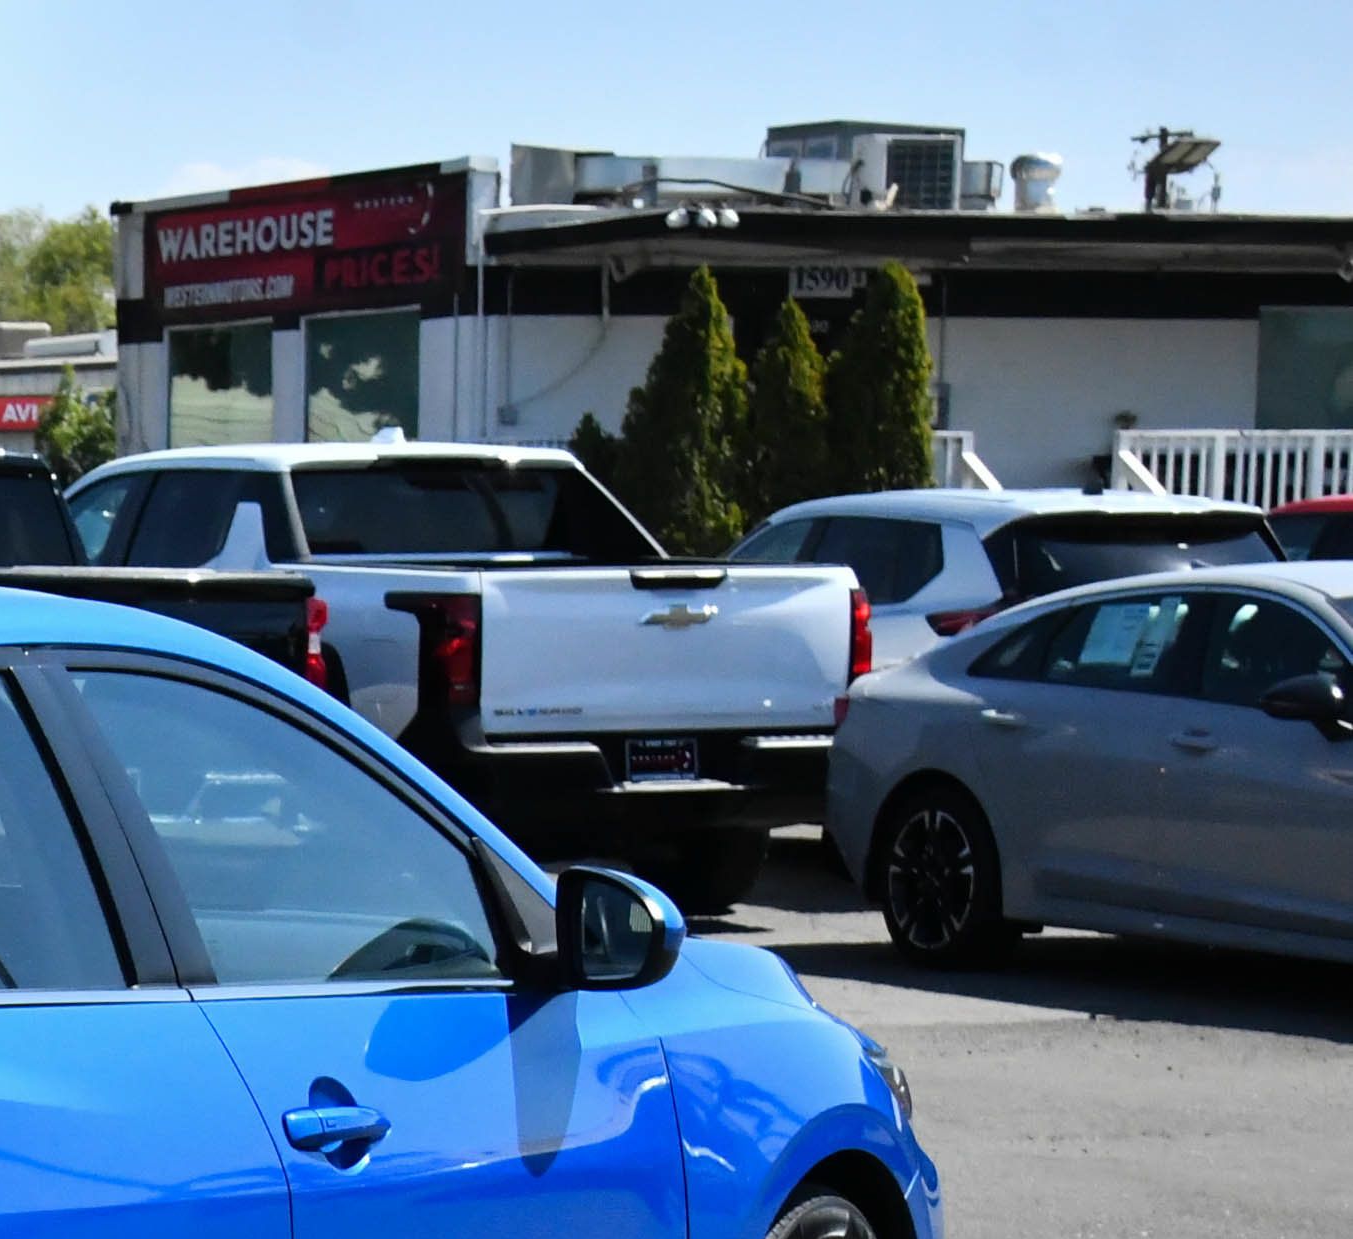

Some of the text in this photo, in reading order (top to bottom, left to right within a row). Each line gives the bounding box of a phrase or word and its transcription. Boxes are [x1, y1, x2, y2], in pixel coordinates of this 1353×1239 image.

[157, 208, 335, 264] WAREHOUSE
[324, 242, 442, 290] PRICES!
[1, 402, 42, 423] AVI
